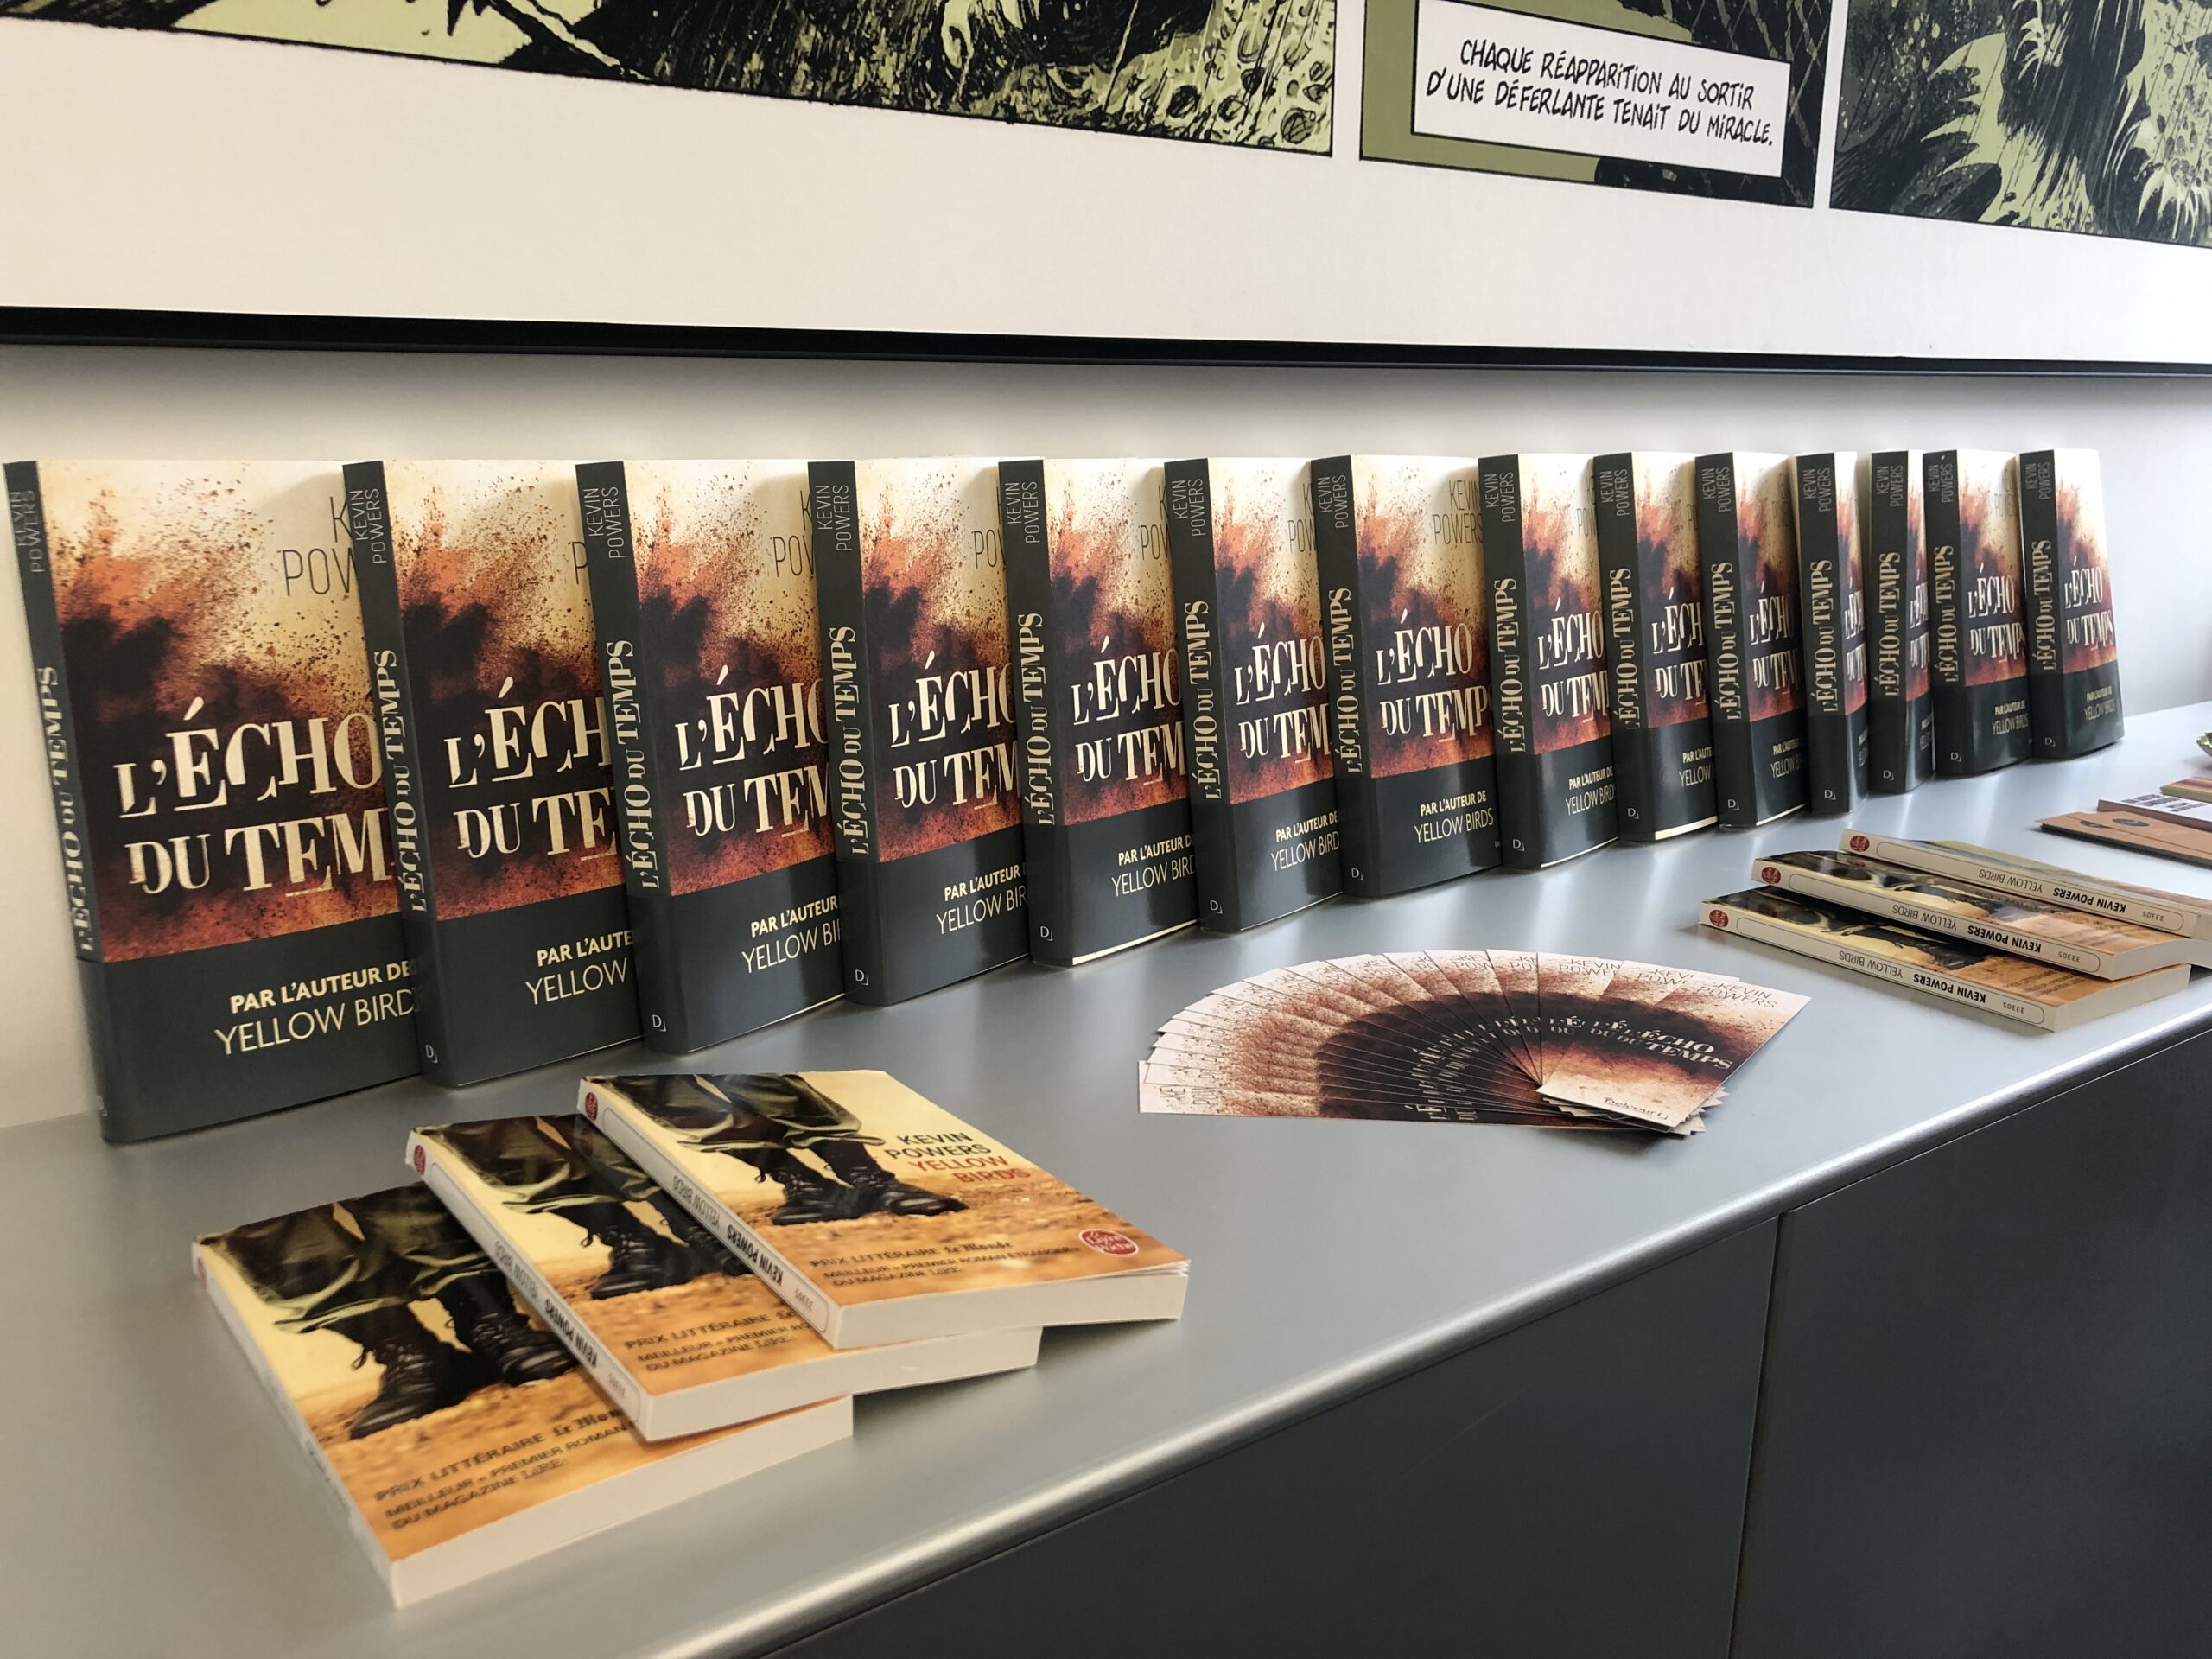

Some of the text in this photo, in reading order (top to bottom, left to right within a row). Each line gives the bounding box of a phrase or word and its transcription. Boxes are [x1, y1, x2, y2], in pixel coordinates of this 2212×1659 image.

[1460, 39, 1754, 111] CHAQUE RÉAPPARITION AU SORTIR
[1427, 68, 1774, 147] D'UNE DÉFERLANTE TENAIT DU MIRACLE.
[1005, 482, 1022, 524] KEVIN
[1172, 479, 1189, 519] KEVIN
[1318, 475, 1333, 513] KEVIN
[1332, 474, 1349, 529] POWERS
[1484, 473, 1499, 508] KEVIN
[1499, 472, 1516, 523] POWERS
[1600, 470, 1614, 504] KEVIN
[1614, 468, 1630, 517] POWERS
[1702, 468, 1716, 500] KEVIN
[1716, 466, 1732, 512] POWERS
[1803, 468, 1816, 499] KEVIN
[1817, 467, 1832, 512] POWERS
[350, 488, 369, 541] KEVIN
[365, 487, 387, 563] POWERS
[583, 487, 603, 537] KEVIN
[601, 486, 626, 558] POWERS
[816, 484, 834, 530] KEVIN
[832, 484, 852, 551] POWERS
[1021, 480, 1041, 543] POWERS
[1187, 478, 1206, 537] POWERS
[1879, 551, 1900, 613] TEMPS
[1934, 545, 1955, 604] TEMPS
[2031, 539, 2052, 596] TEMPS
[2063, 556, 2103, 608] L'ÉCHO
[1967, 563, 2015, 619] L'ÉCHO
[1375, 608, 1474, 686] L'ÉCHO
[1537, 597, 1605, 671] L'ÉCHO
[1609, 568, 1641, 730] L'ÉCHO DU TEMPS
[1711, 562, 1742, 720] L'ÉCHO DU TEMPS
[1810, 559, 1838, 713] L'ÉCHO DU TEMPS
[1970, 627, 1986, 656] DU
[2066, 610, 2114, 651] DU TEMPS
[1071, 635, 1182, 726] L'ÉCHO
[1234, 621, 1327, 706] L'ÉCHO
[1328, 588, 1363, 773] L'ÉCHO DU TEMPS
[1493, 577, 1526, 753] L'ÉCHO DU TEMPS
[1655, 664, 1678, 699] DU
[1017, 613, 1055, 826] L'ÉCHO DU TEMPS
[1184, 601, 1222, 800] L'ÉCHO DU TEMPS
[1380, 697, 1412, 736] DU
[1541, 680, 1565, 718] DU
[114, 696, 384, 819] L'ÉCHO
[829, 626, 869, 855] L'ÉCHO DU TEMPS
[1075, 736, 1112, 783] DU
[1238, 716, 1270, 760] DU
[1682, 752, 1694, 764] PAR
[373, 649, 426, 912] L'ÉCHO DU TEMPS
[606, 639, 659, 889] L'ÉCHO DU TEMPS
[893, 759, 937, 809] DU
[1568, 778, 1581, 791] PAR
[1679, 764, 1712, 788] YELLOW
[683, 783, 736, 837] DU
[1420, 790, 1487, 817] PAR L'AUTEUR DE
[1565, 788, 1599, 816] YELLOW
[454, 802, 521, 859] DU
[1275, 815, 1328, 843] PAR L'AUTEUR
[1414, 807, 1494, 844] YELLOW BIRDS
[124, 834, 212, 895] DU
[1118, 836, 1185, 867] PAR L'AUTEUR
[1271, 839, 1317, 872] YELLOW
[944, 863, 1020, 901] PAR L'AUTEUR
[1111, 861, 1168, 898] YELLOW
[1978, 868, 2005, 884] BIRDS
[2007, 875, 2044, 893] YELLOW
[2052, 887, 2094, 906] POWERS
[750, 895, 839, 938] PAR L'AUTEUR
[936, 891, 1002, 935] YELLOW
[1892, 903, 1919, 920] BIRDS
[1920, 912, 1957, 931] YELLOW
[2095, 897, 2127, 914] KEVIN
[741, 925, 818, 975] YELLOW
[1967, 925, 2010, 945] POWERS
[2011, 936, 2042, 954] KEVIN
[537, 948, 572, 967] PAR
[1838, 950, 1866, 968] BIRDS
[1866, 959, 1903, 978] YELLOW
[230, 967, 383, 1014] PAR L'AUTEUR
[525, 957, 629, 1006] YELLOW
[1696, 986, 1778, 1010] POWERS
[1718, 982, 1772, 1000] KEVIN
[1912, 973, 1955, 994] POWERS
[1955, 985, 1986, 1004] KEVIN
[214, 1002, 346, 1056] YELLOW
[1644, 1040, 1733, 1071] TEMPS
[883, 1143, 993, 1160] POWERS
[897, 1131, 975, 1146] KEVIN
[907, 1155, 1010, 1173] YELLOW
[951, 1167, 1033, 1185] BIRDS
[727, 1224, 785, 1287] KEVIN POWERS
[809, 1256, 850, 1268] PRIX
